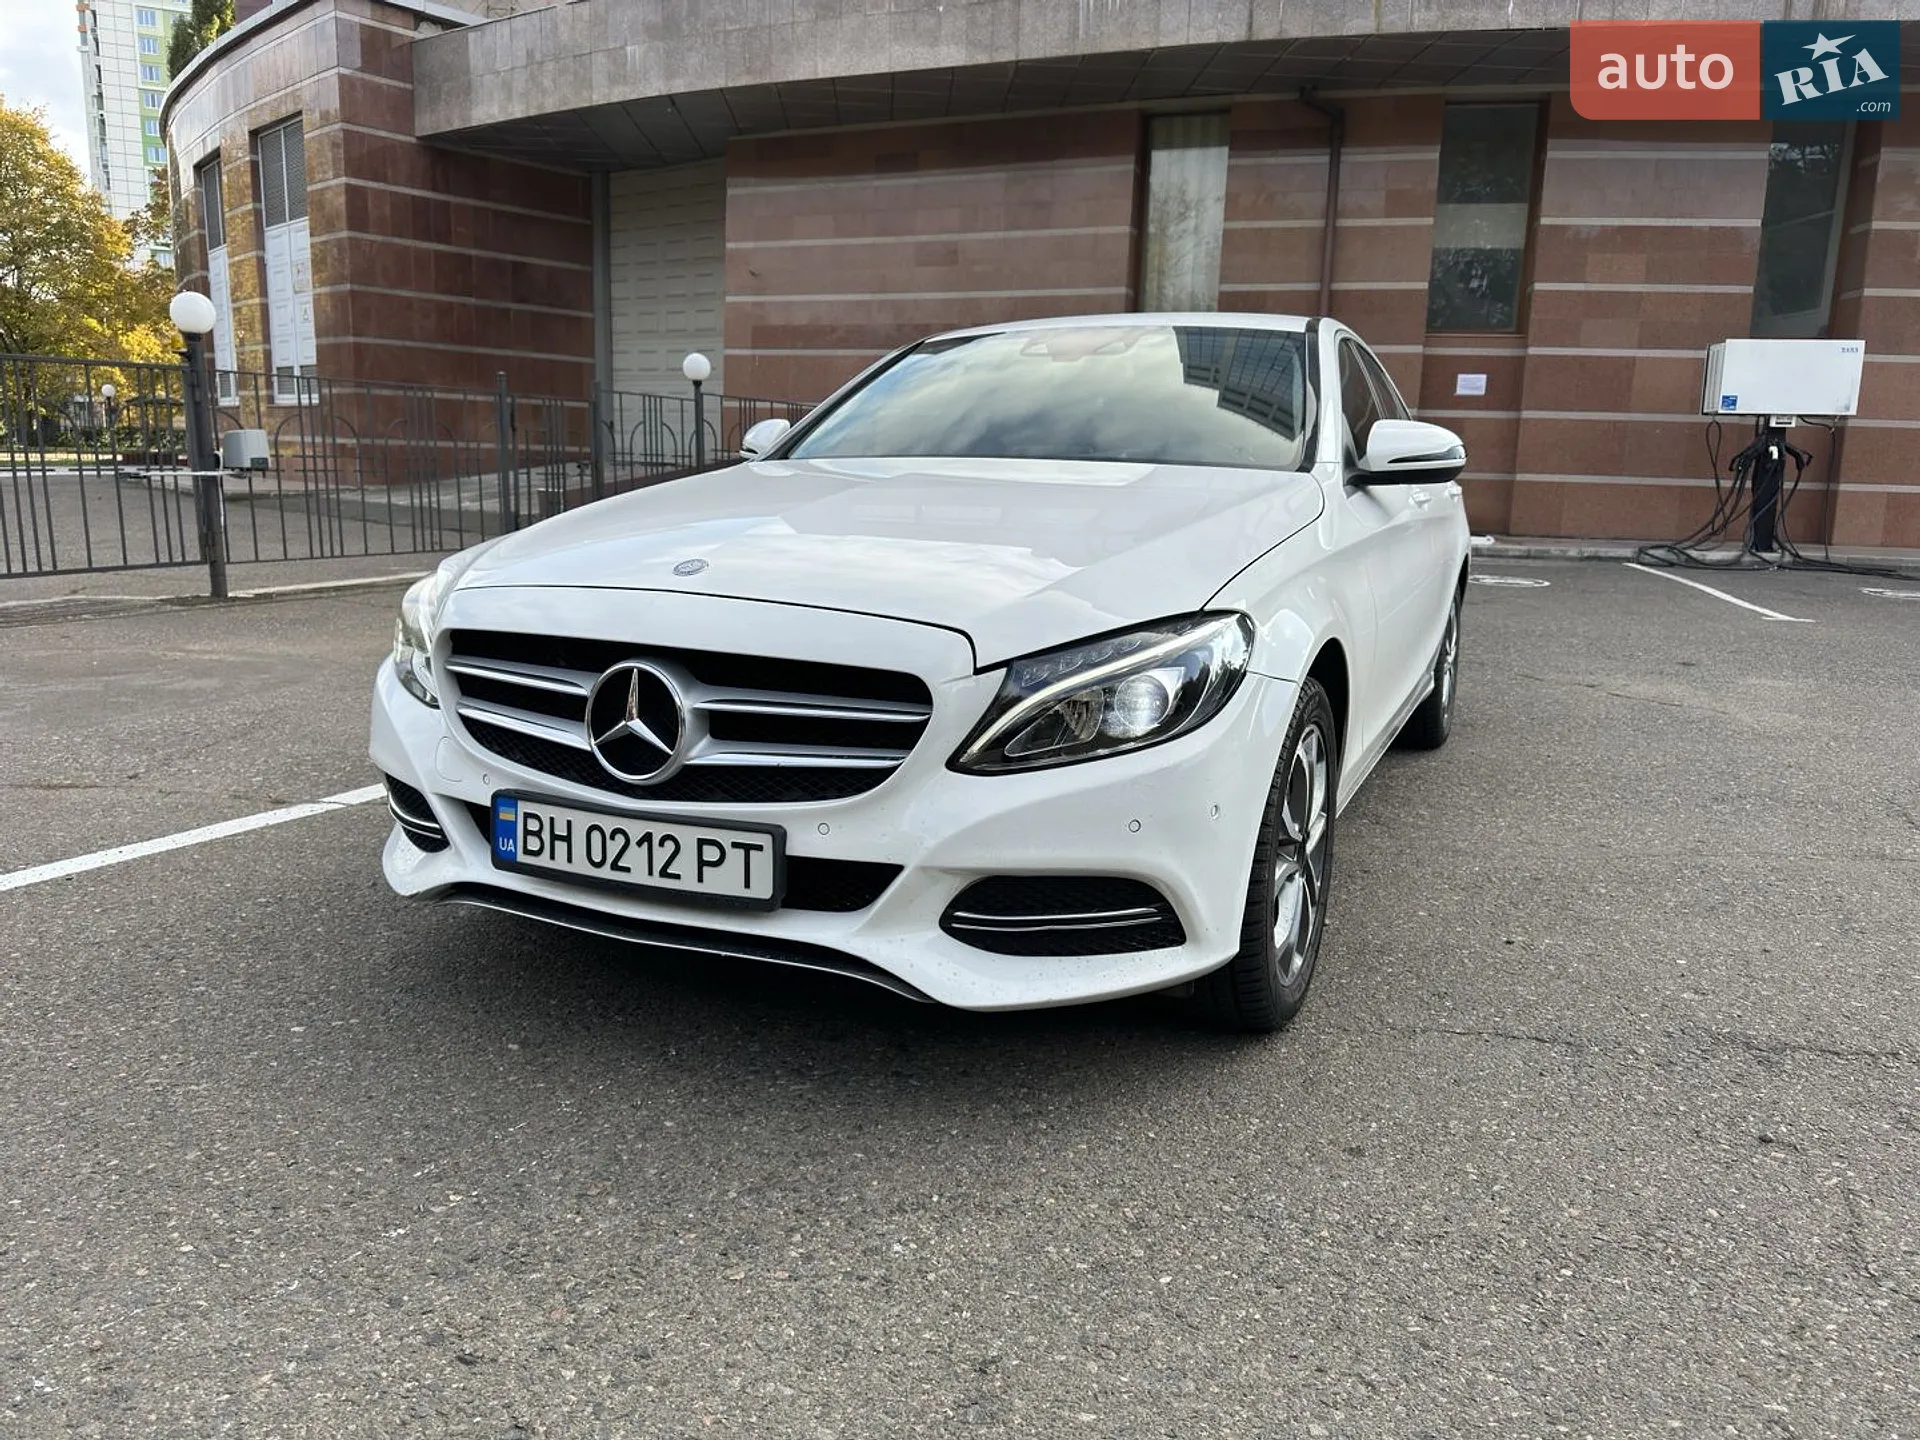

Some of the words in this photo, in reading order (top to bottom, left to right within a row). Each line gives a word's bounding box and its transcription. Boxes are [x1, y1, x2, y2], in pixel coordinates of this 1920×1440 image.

[499, 837, 516, 853] UA
[522, 811, 573, 864] BH
[585, 823, 682, 880] 0212
[696, 837, 764, 889] PT
